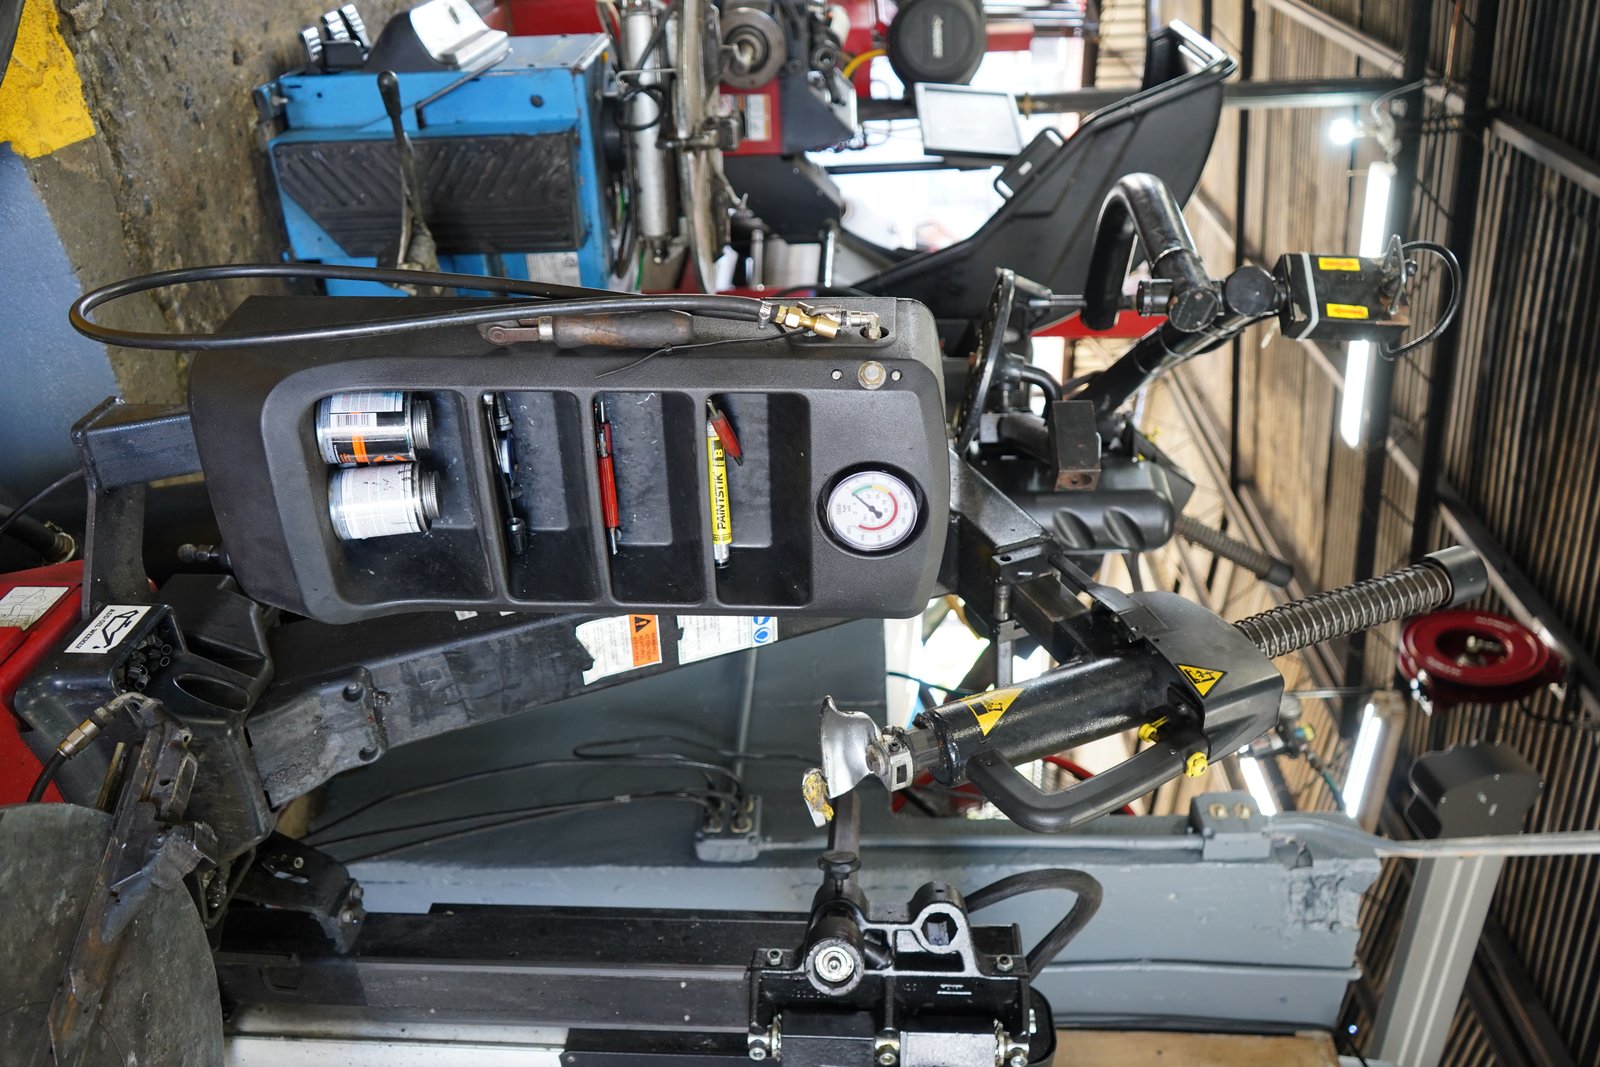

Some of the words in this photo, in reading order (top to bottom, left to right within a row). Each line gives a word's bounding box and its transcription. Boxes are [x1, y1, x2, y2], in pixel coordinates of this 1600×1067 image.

[715, 448, 723, 459] B
[715, 473, 726, 530] PAINTSTIK
[103, 609, 115, 619] ADD
[94, 620, 106, 630] OIL
[76, 629, 96, 649] WEEKLY
